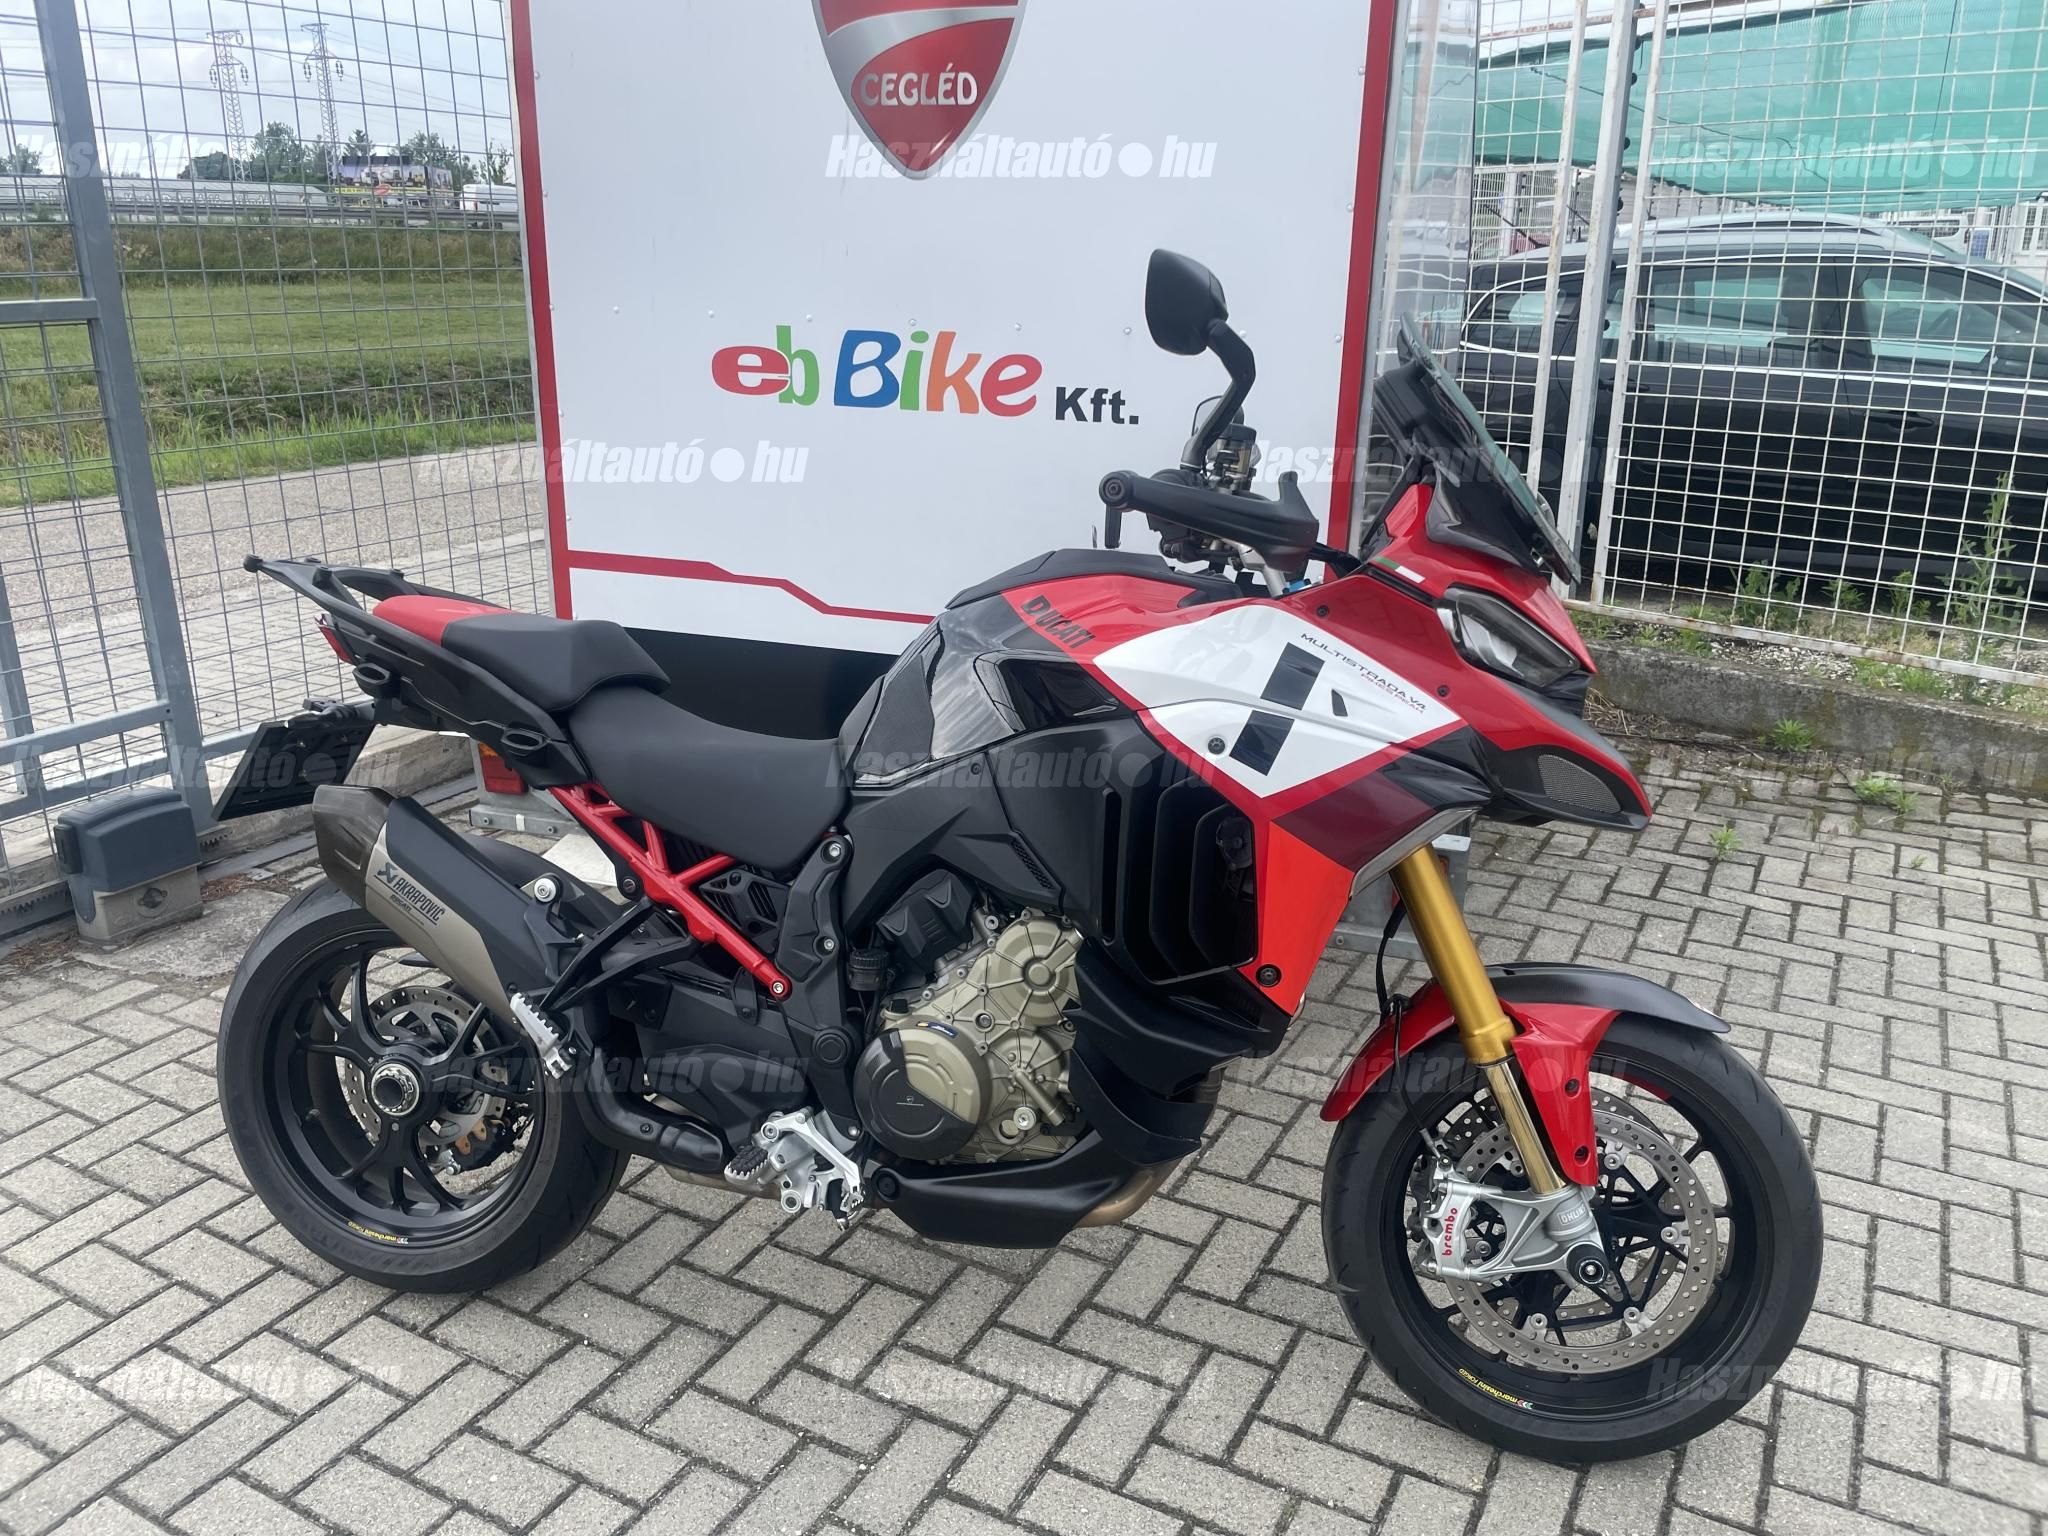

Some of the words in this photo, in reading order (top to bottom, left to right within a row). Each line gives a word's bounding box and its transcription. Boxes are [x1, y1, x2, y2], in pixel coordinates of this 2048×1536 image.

[860, 62, 978, 106] CEGLÉD
[1055, 386, 1139, 425] Kft.
[1021, 594, 1097, 649] DUCATI
[1301, 633, 1405, 697] MULTISTRADA
[1442, 1207, 1458, 1257] brembo
[1476, 1380, 1518, 1404] marchesini
